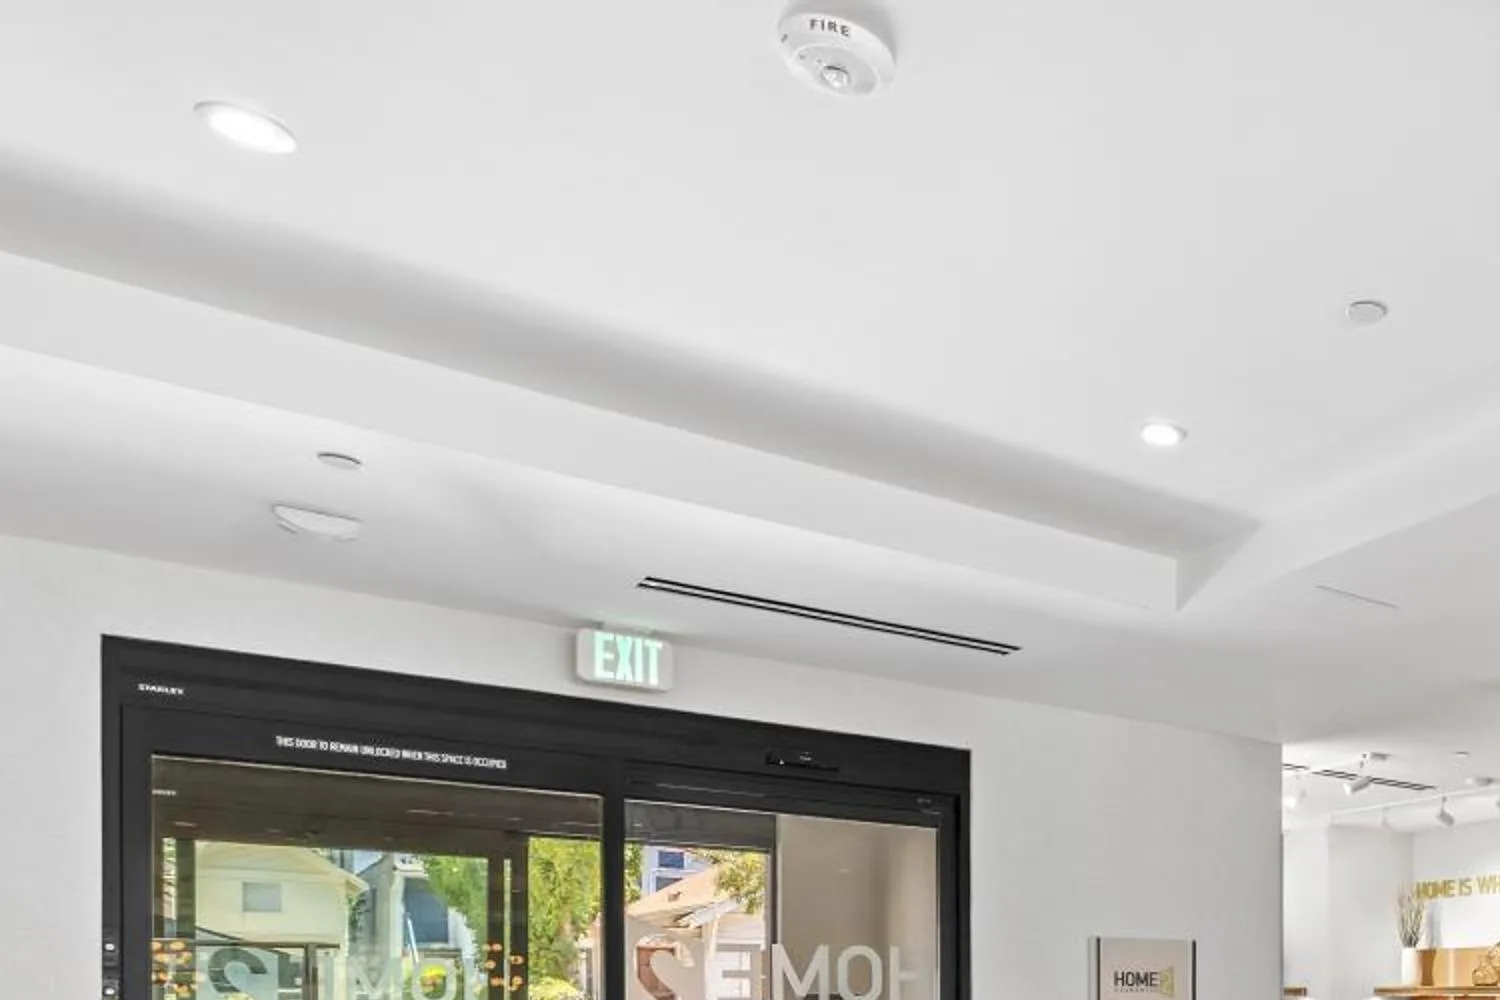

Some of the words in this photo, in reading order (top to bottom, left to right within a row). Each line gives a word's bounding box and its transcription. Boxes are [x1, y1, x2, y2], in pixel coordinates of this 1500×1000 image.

[808, 18, 850, 38] FIRE
[594, 630, 663, 687] EXIT
[276, 736, 294, 748] THIS
[295, 738, 317, 750] DOOR
[319, 740, 327, 751] TO
[329, 741, 358, 754] REMAIN
[360, 745, 400, 759] UNLOCKED
[424, 751, 441, 763] THIS
[1458, 877, 1473, 897] IS
